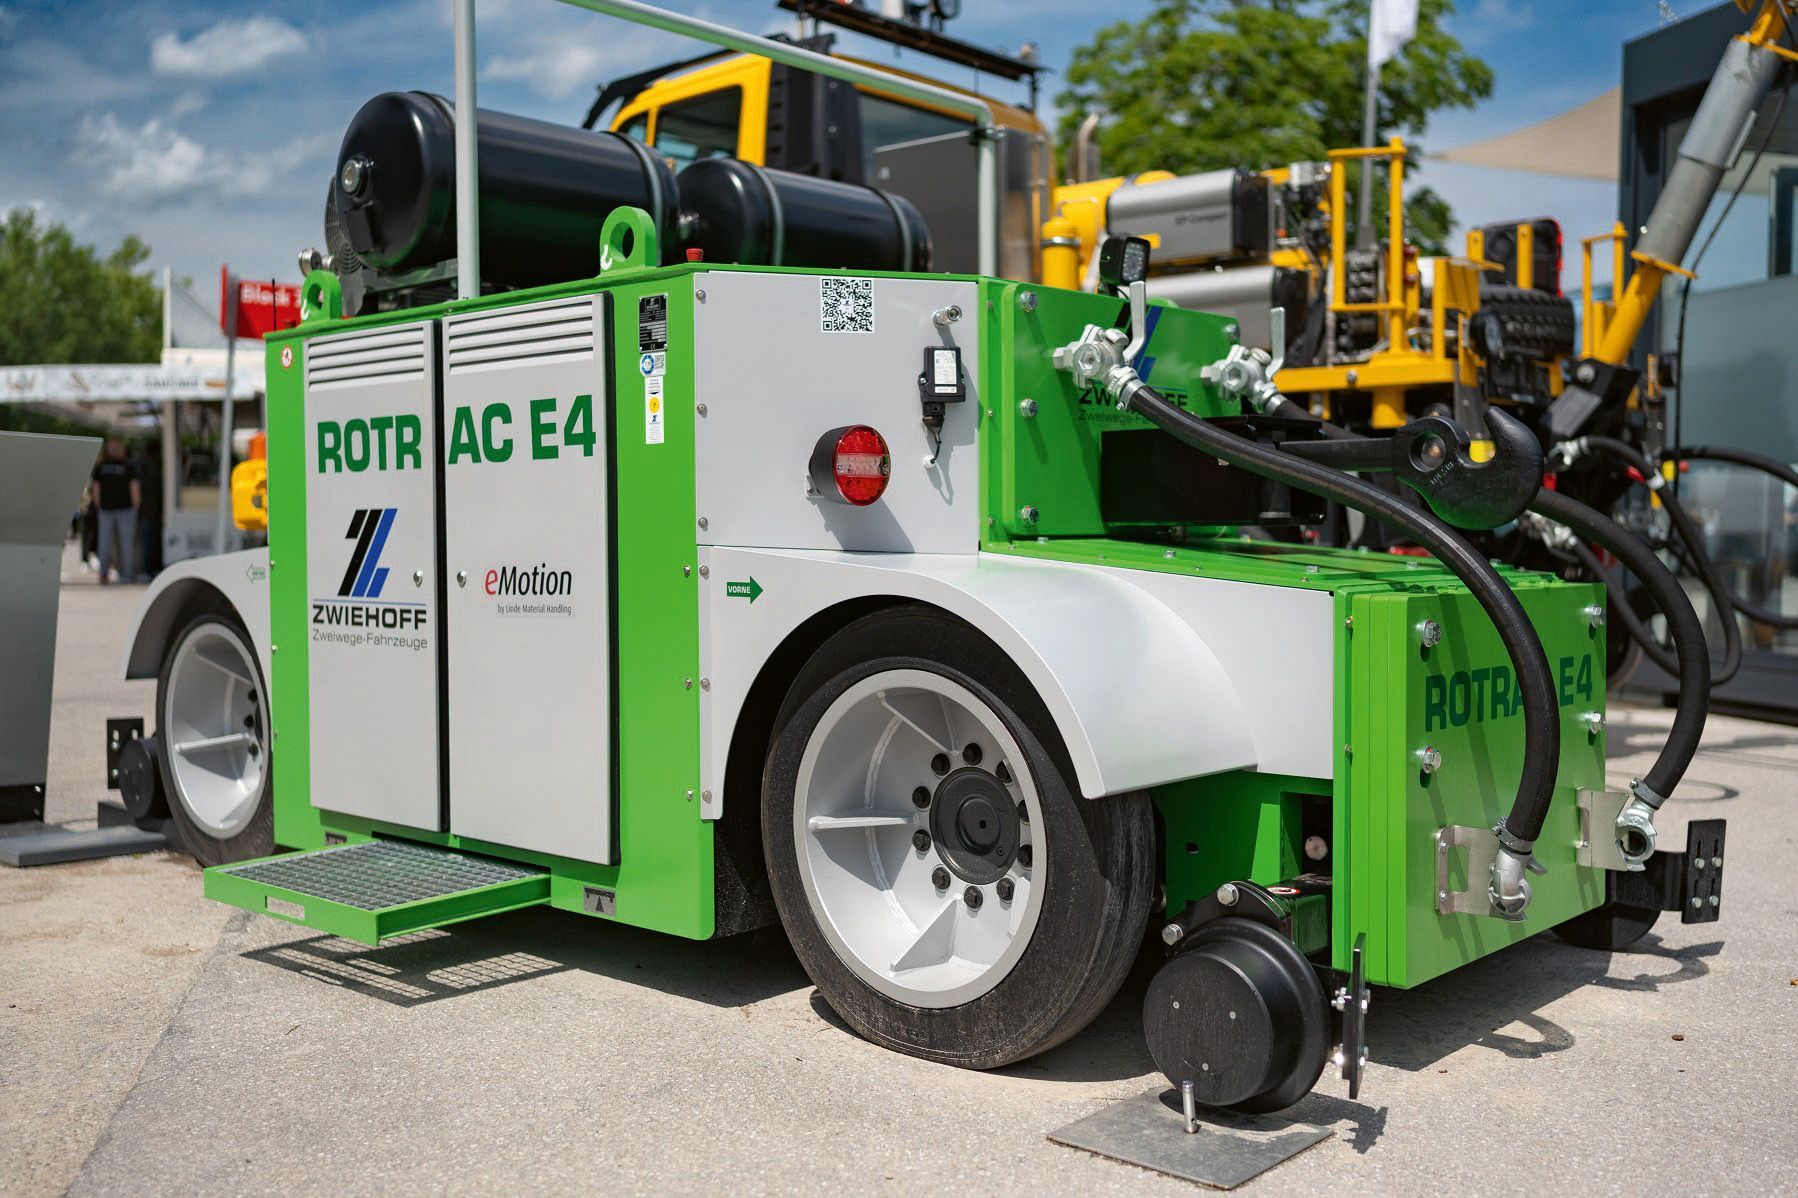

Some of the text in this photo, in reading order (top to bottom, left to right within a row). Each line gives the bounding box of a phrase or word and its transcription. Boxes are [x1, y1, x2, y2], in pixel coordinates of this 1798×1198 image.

[530, 394, 597, 460] E4
[485, 562, 572, 596] eMotion
[728, 585, 751, 594] VORNE
[313, 604, 427, 631] ZWIEHOFF
[497, 604, 572, 616] by Linde Material Handling
[312, 629, 428, 651] Zweiwege-Fahrzeuge
[1559, 653, 1593, 707] E4
